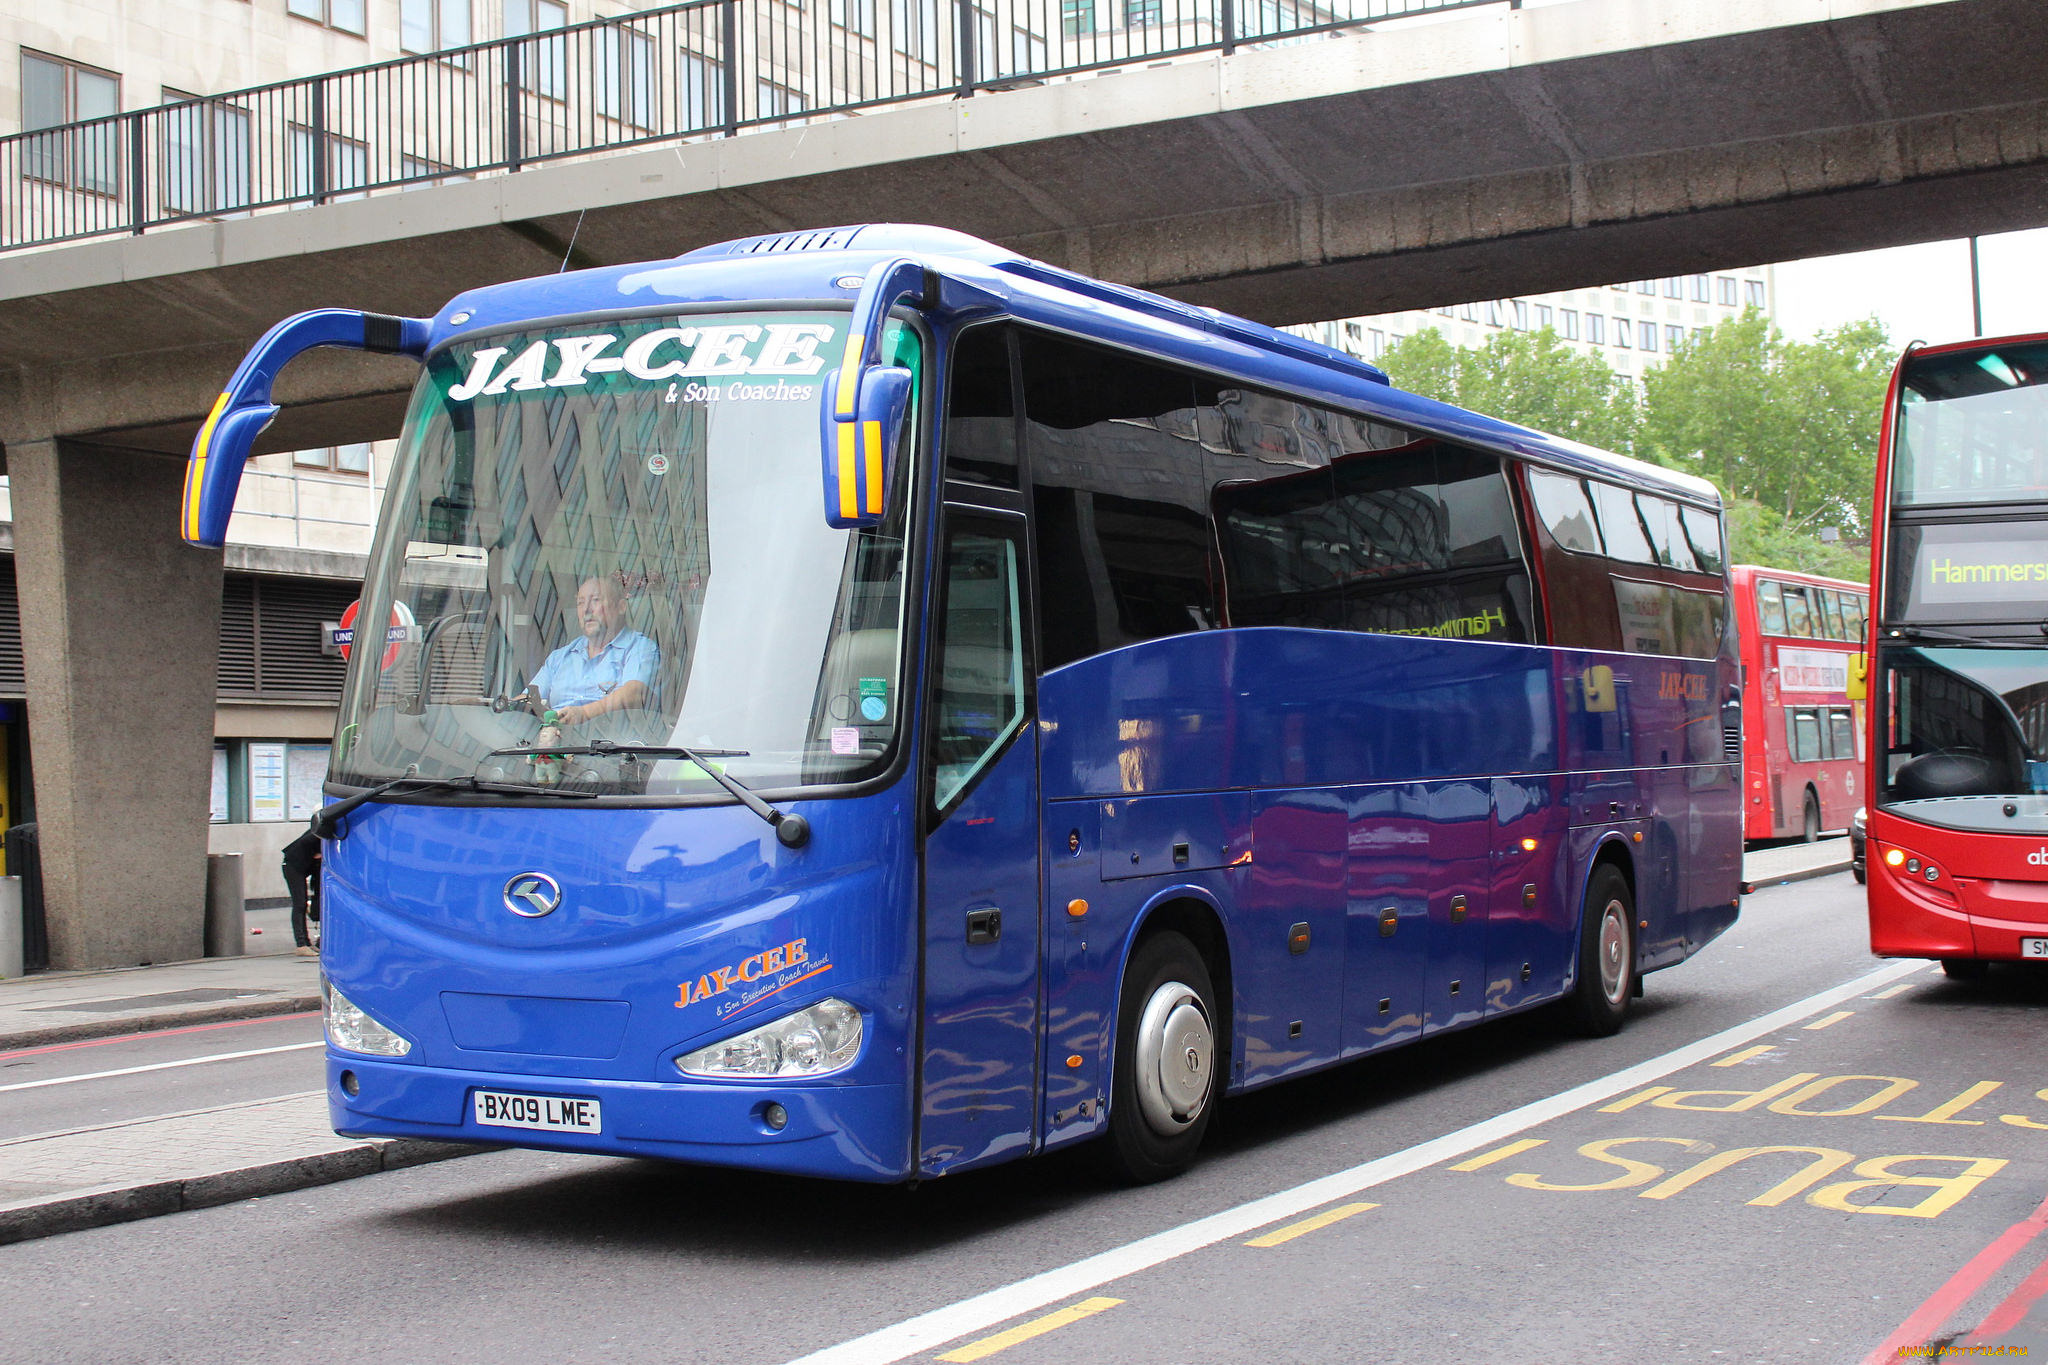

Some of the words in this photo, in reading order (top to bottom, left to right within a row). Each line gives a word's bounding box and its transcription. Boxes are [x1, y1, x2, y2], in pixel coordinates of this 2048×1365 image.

[448, 323, 836, 402] JAY-CEE
[664, 382, 679, 402] &
[683, 382, 720, 402] Son
[728, 378, 813, 401] Coaches
[1931, 558, 2048, 584] Hammers
[335, 630, 406, 642] UNDUND
[1658, 671, 1707, 699] JAY-CEE
[674, 938, 809, 1009] JAY-CEE
[716, 1006, 723, 1016] &
[725, 1001, 740, 1013] Son
[741, 982, 776, 1004] Executive
[778, 966, 802, 987] Coach
[802, 953, 830, 972] Travel
[484, 1094, 540, 1123] BX09
[546, 1099, 591, 1127] LME
[1505, 1137, 2010, 1218] BUS
